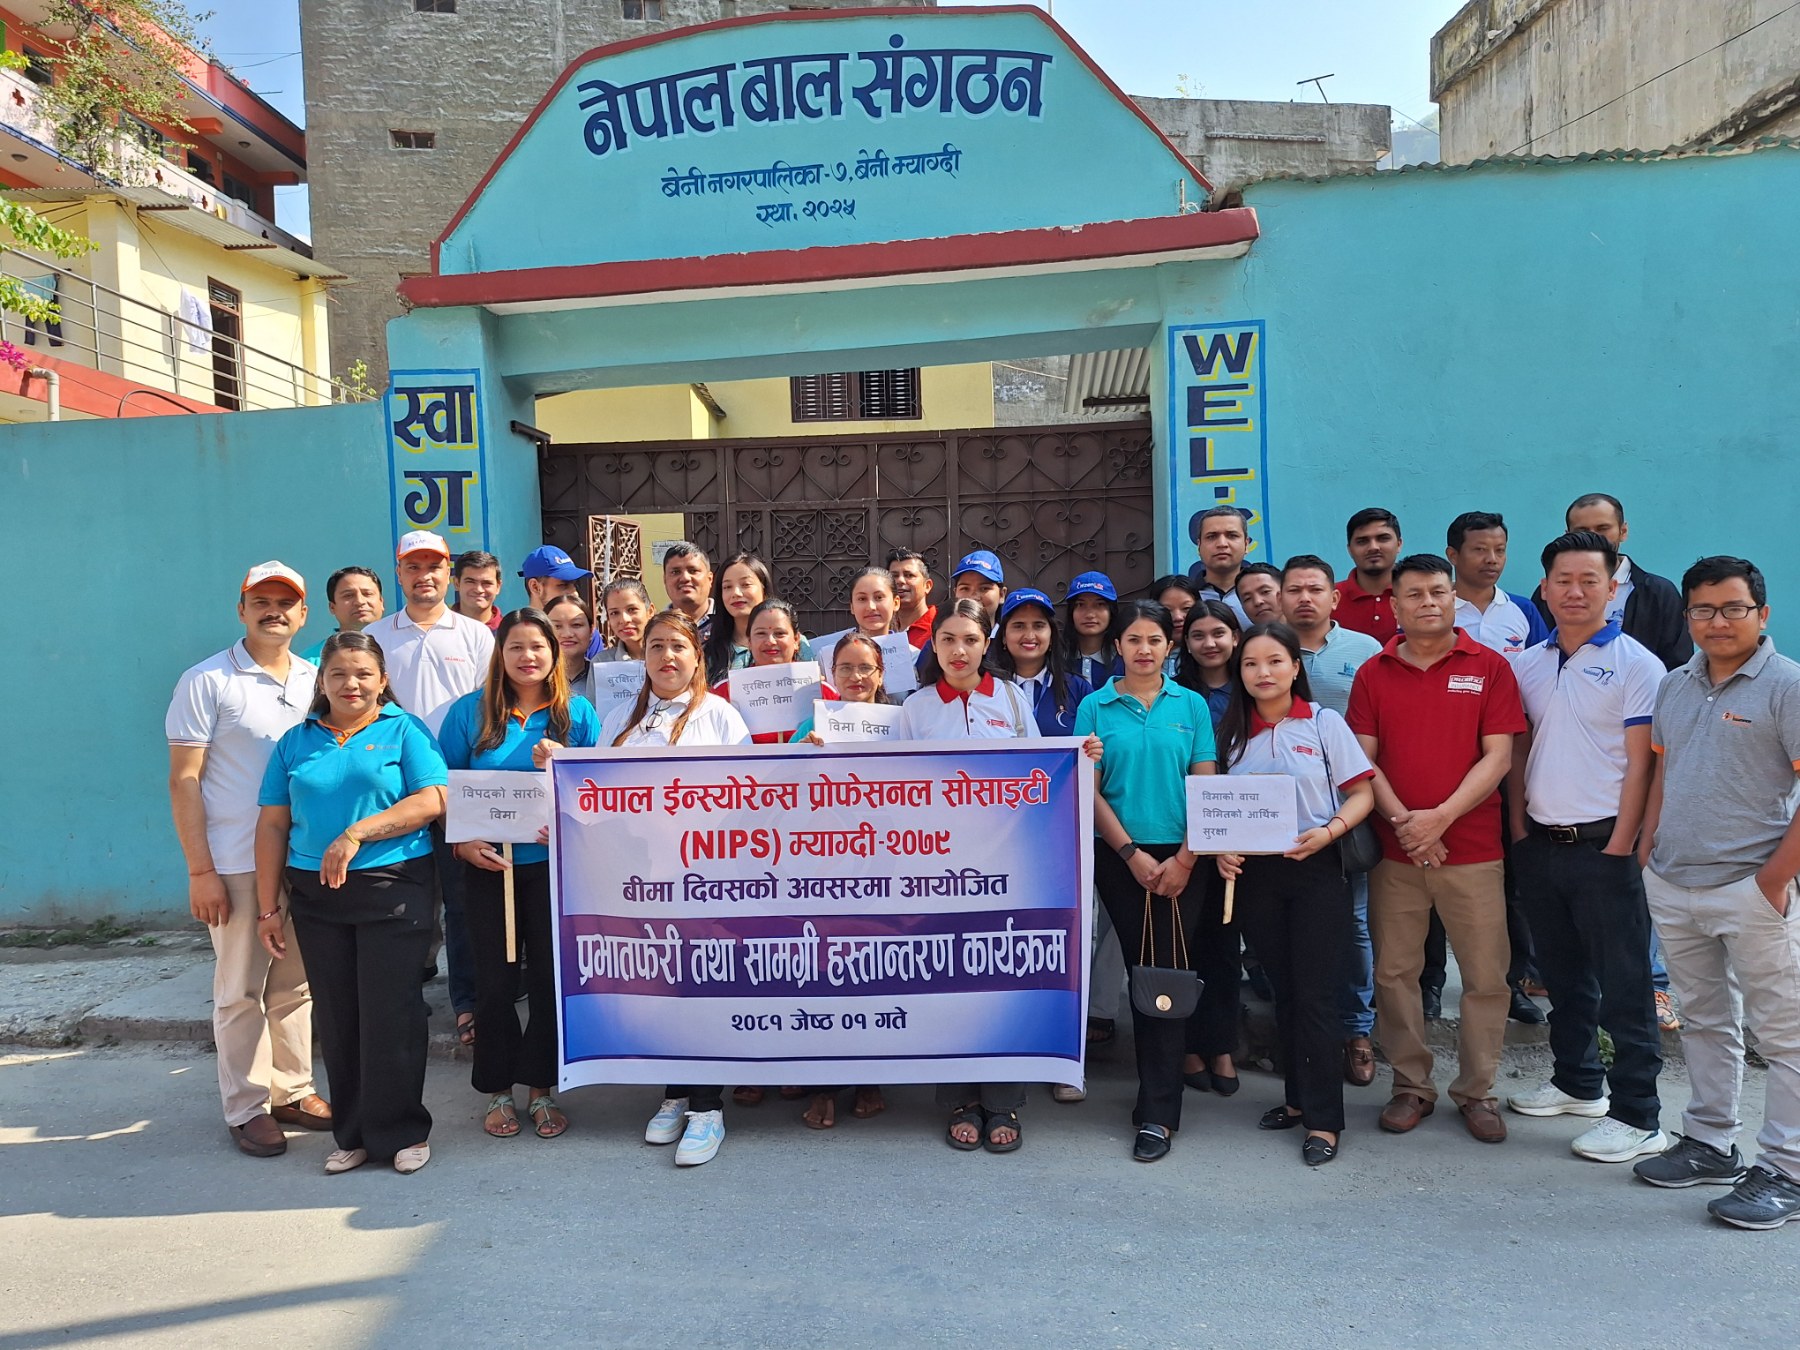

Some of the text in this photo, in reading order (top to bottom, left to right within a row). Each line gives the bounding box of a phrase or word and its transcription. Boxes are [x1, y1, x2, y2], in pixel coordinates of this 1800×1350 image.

[577, 35, 1054, 156] नेपाल बाल संगठन
[661, 166, 706, 198] बेनी
[855, 149, 890, 181] बेनी
[803, 198, 856, 222] २०२५
[742, 679, 772, 695] सुरक्षित
[749, 694, 792, 708] लागि विमा
[829, 718, 890, 736] विमा दिवस
[462, 785, 505, 799] विपदको
[577, 768, 1051, 816] नेपाल ईन्स्योरेन्स प्रोफेसनल सोसाइटी
[1202, 791, 1260, 801] विमाको वाचा
[490, 807, 517, 820] विमा
[1247, 809, 1279, 819] आर्थिक
[1203, 829, 1227, 839] सुरक्षा
[679, 828, 782, 868] (NIPS)
[622, 868, 1009, 903] बीमा दिवसको अवसरमा आयोजित
[576, 916, 1067, 989] प्रभातफेरी तथा सामग्री हस्तान्तरण कार्यक्रम
[731, 1006, 907, 1031] २०८१ जेष्ठ ०१ गते
